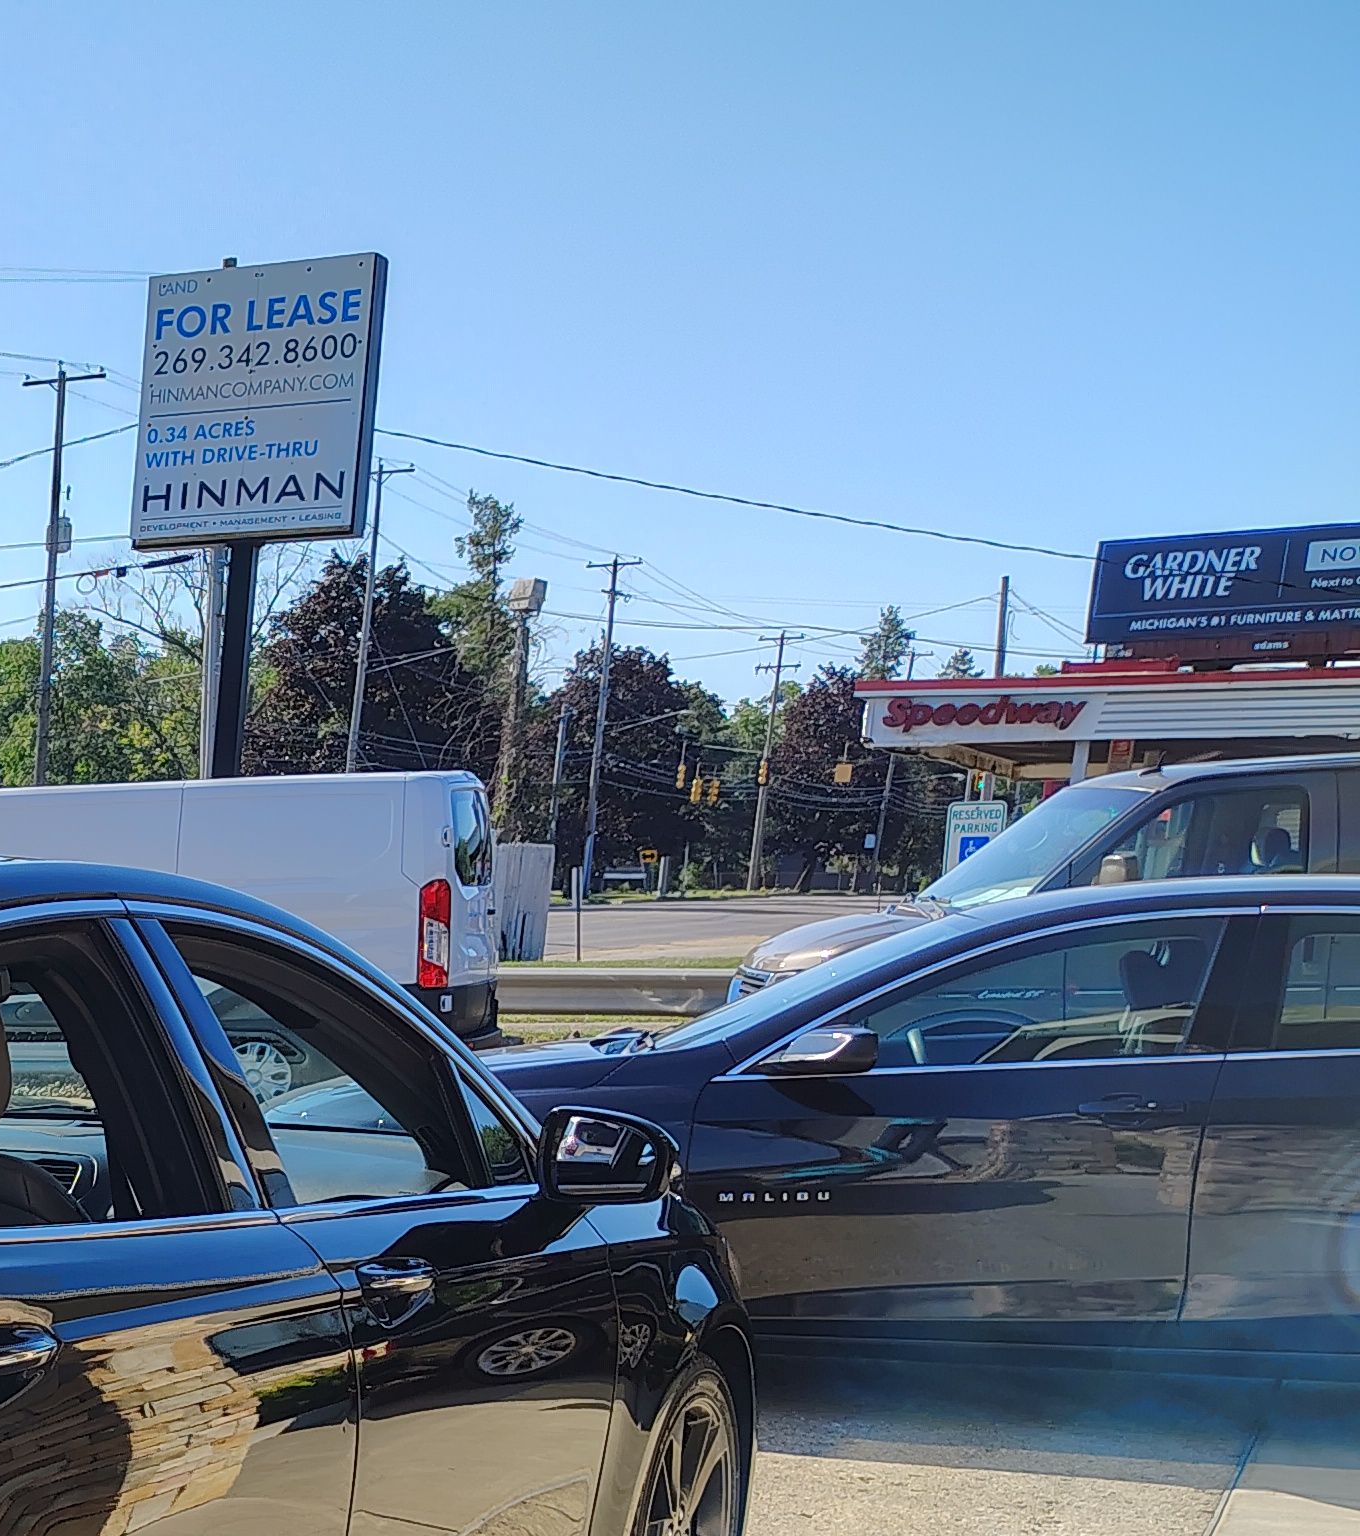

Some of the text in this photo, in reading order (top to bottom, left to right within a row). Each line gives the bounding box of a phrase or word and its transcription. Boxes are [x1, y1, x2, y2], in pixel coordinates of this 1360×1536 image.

[158, 279, 198, 297] LAND
[155, 288, 362, 340] FOR LEASE
[153, 333, 358, 376] 269.342.8600
[149, 372, 354, 404] HINMANCOMPANY.COM
[147, 420, 255, 444] 0.34 ACRES
[145, 440, 318, 469] WITH DRIVE-THRU
[141, 470, 346, 513] HINMAN
[139, 511, 342, 533] DEVELOPMENT MANAGEMENT LEASING
[1124, 546, 1262, 579] GARDNER
[1320, 546, 1360, 563] NO
[1142, 573, 1235, 601] WHITE
[1311, 577, 1340, 589] Next
[1341, 577, 1354, 586] to
[1130, 616, 1208, 632] MICHIGAN'S
[1210, 615, 1226, 627] #1
[1230, 610, 1301, 626] FURNITURE
[1304, 609, 1315, 622] &
[882, 695, 1087, 733] Speedway
[952, 809, 1002, 820] RESERVED
[953, 823, 998, 833] PARKING
[718, 1191, 830, 1202] MALIBU
